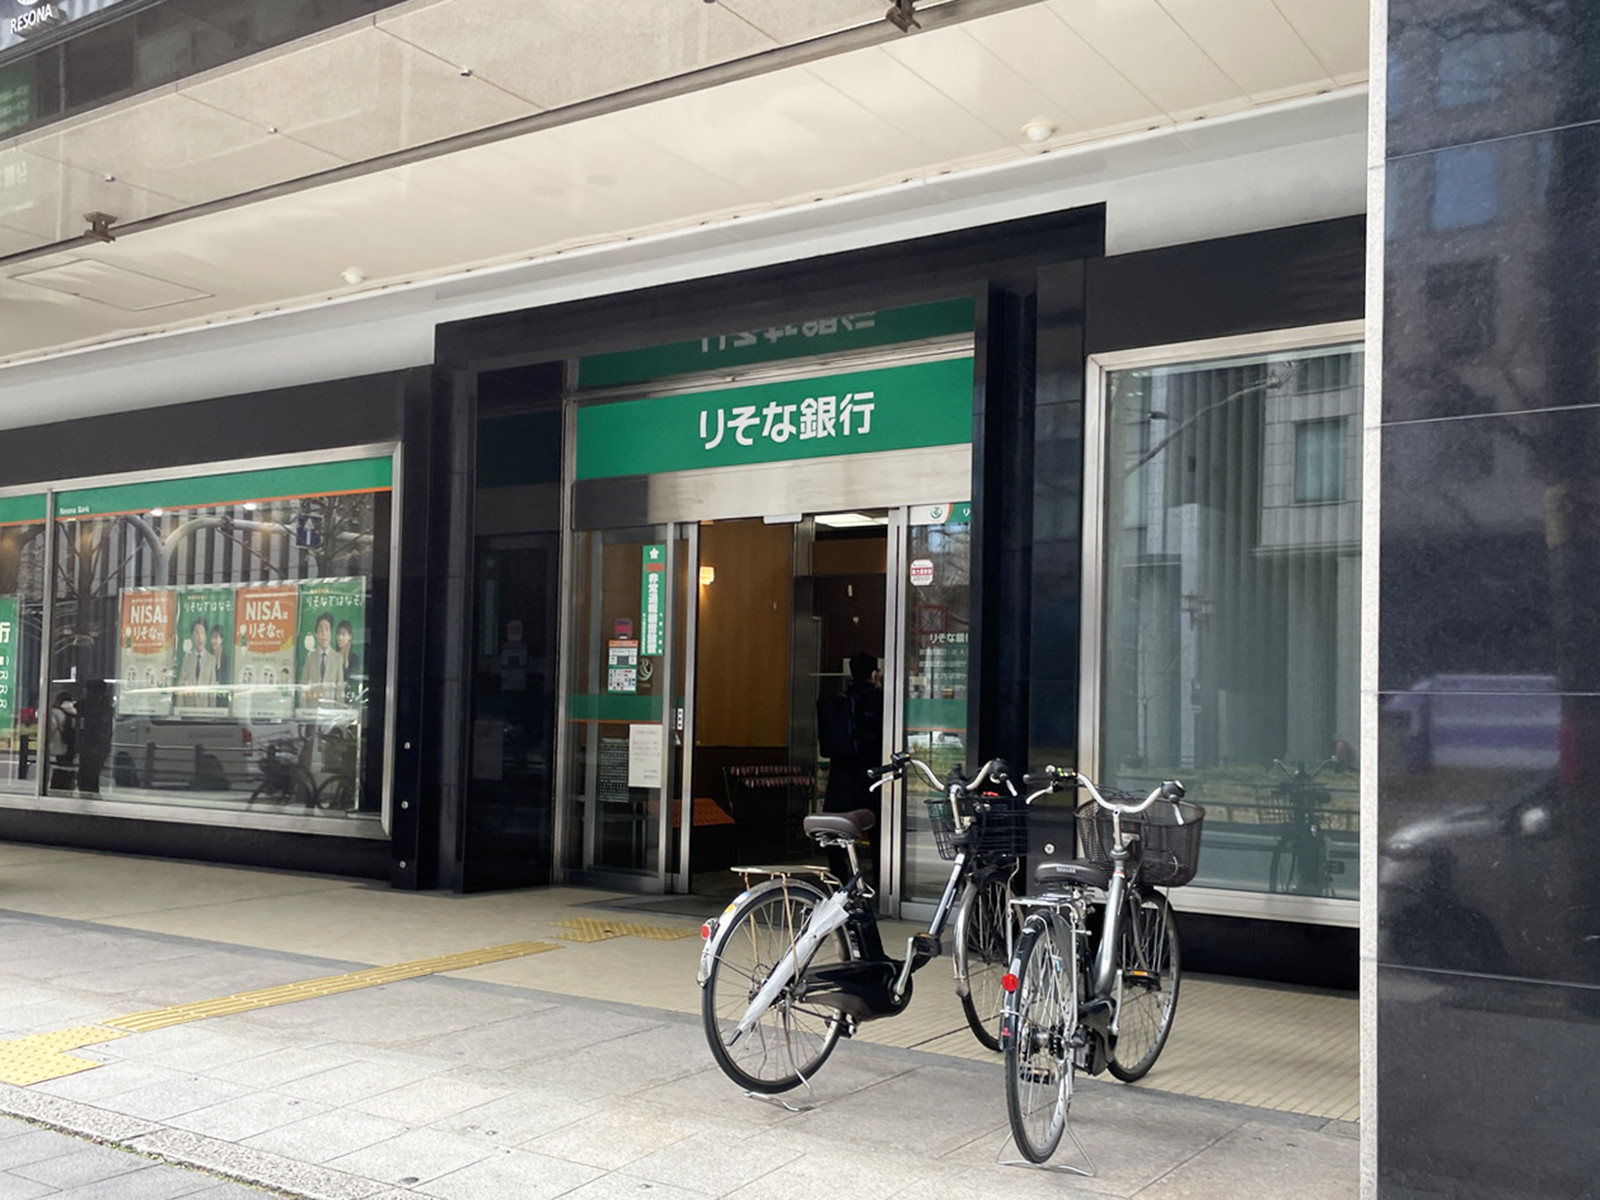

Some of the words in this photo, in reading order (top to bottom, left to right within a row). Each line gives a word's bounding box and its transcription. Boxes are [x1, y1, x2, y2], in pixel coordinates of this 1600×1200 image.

[10, 3, 53, 34] RESONA
[699, 391, 875, 450] りそな銀行
[306, 594, 362, 607] りそなではなそ
[930, 632, 968, 644] りそな銀
